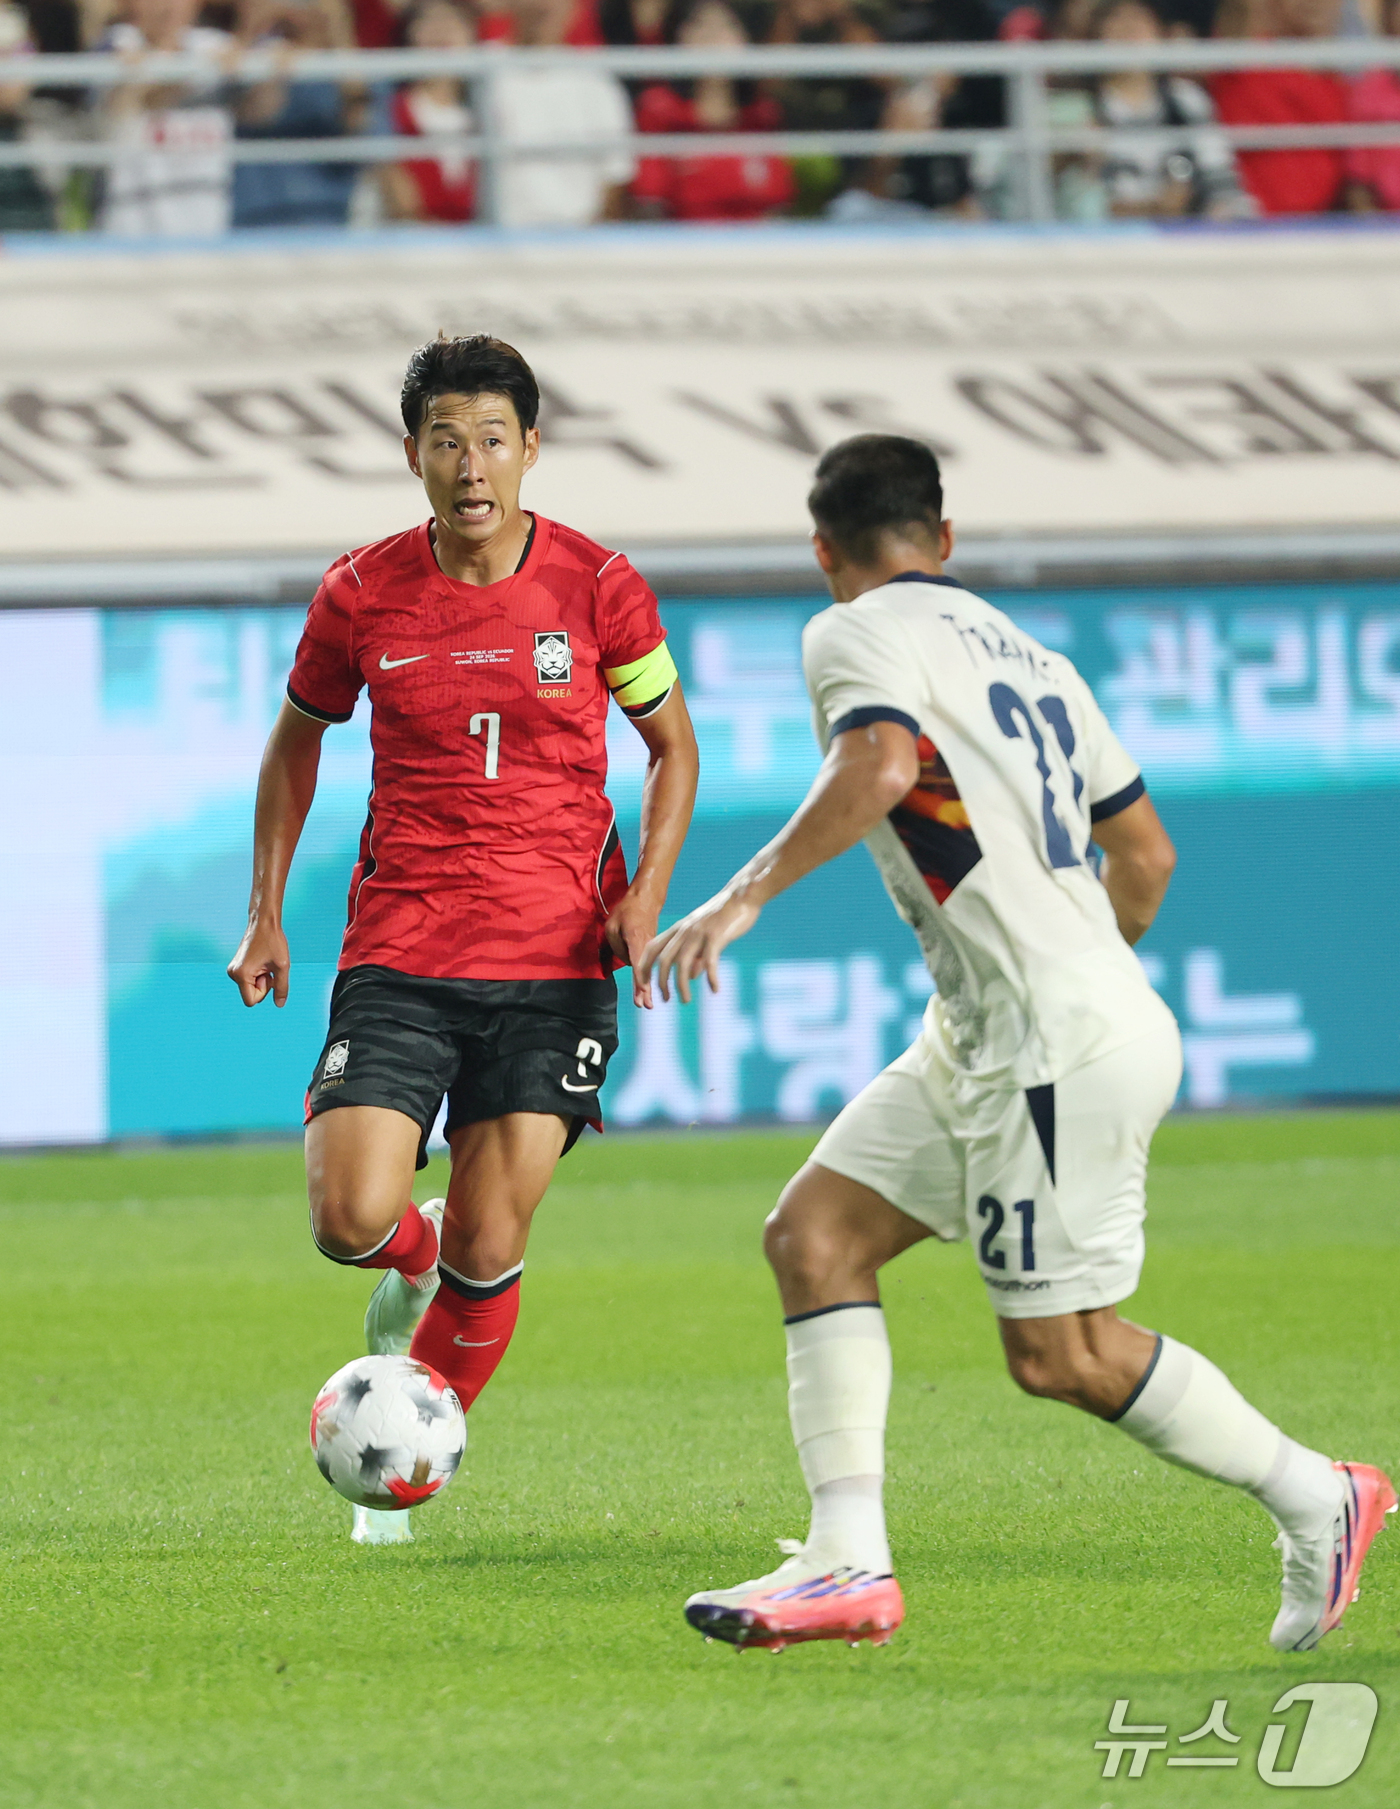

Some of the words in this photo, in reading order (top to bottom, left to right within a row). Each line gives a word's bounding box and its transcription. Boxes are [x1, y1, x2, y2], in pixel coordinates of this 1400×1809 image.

[537, 688, 572, 698] KOREA
[468, 712, 501, 779] 7
[320, 1078, 345, 1090] KOREA
[978, 1194, 1035, 1271] 21
